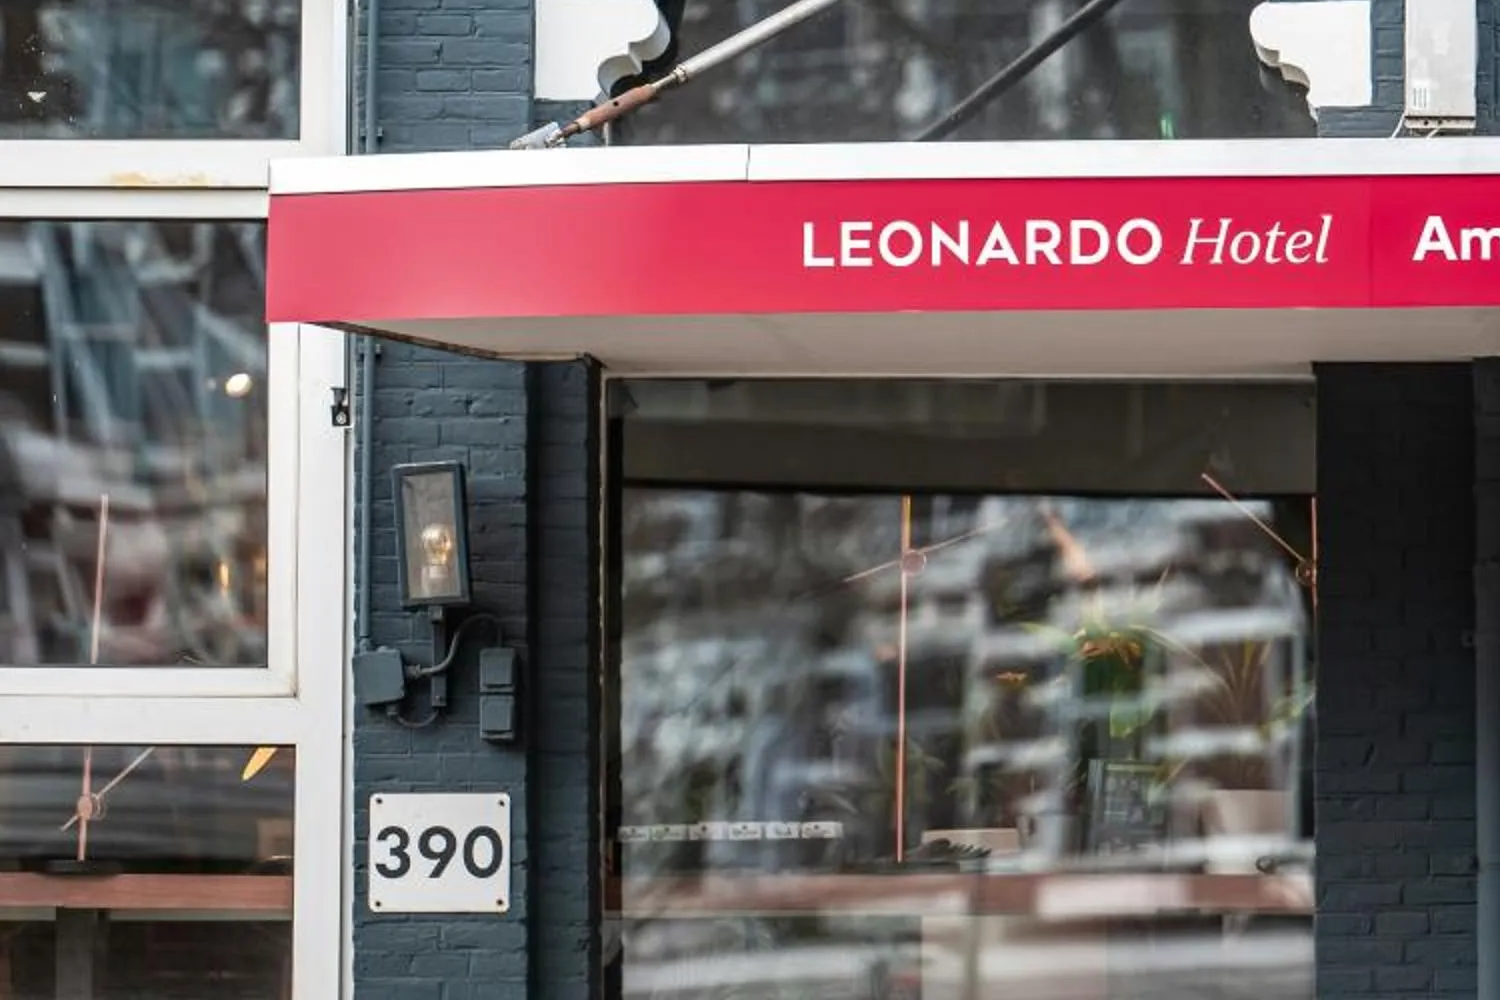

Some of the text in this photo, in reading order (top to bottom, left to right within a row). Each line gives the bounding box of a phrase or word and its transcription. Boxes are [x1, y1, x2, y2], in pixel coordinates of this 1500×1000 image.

[803, 217, 1163, 268] LEONARDO
[1180, 214, 1333, 266] Hotel
[374, 825, 504, 879] 390
